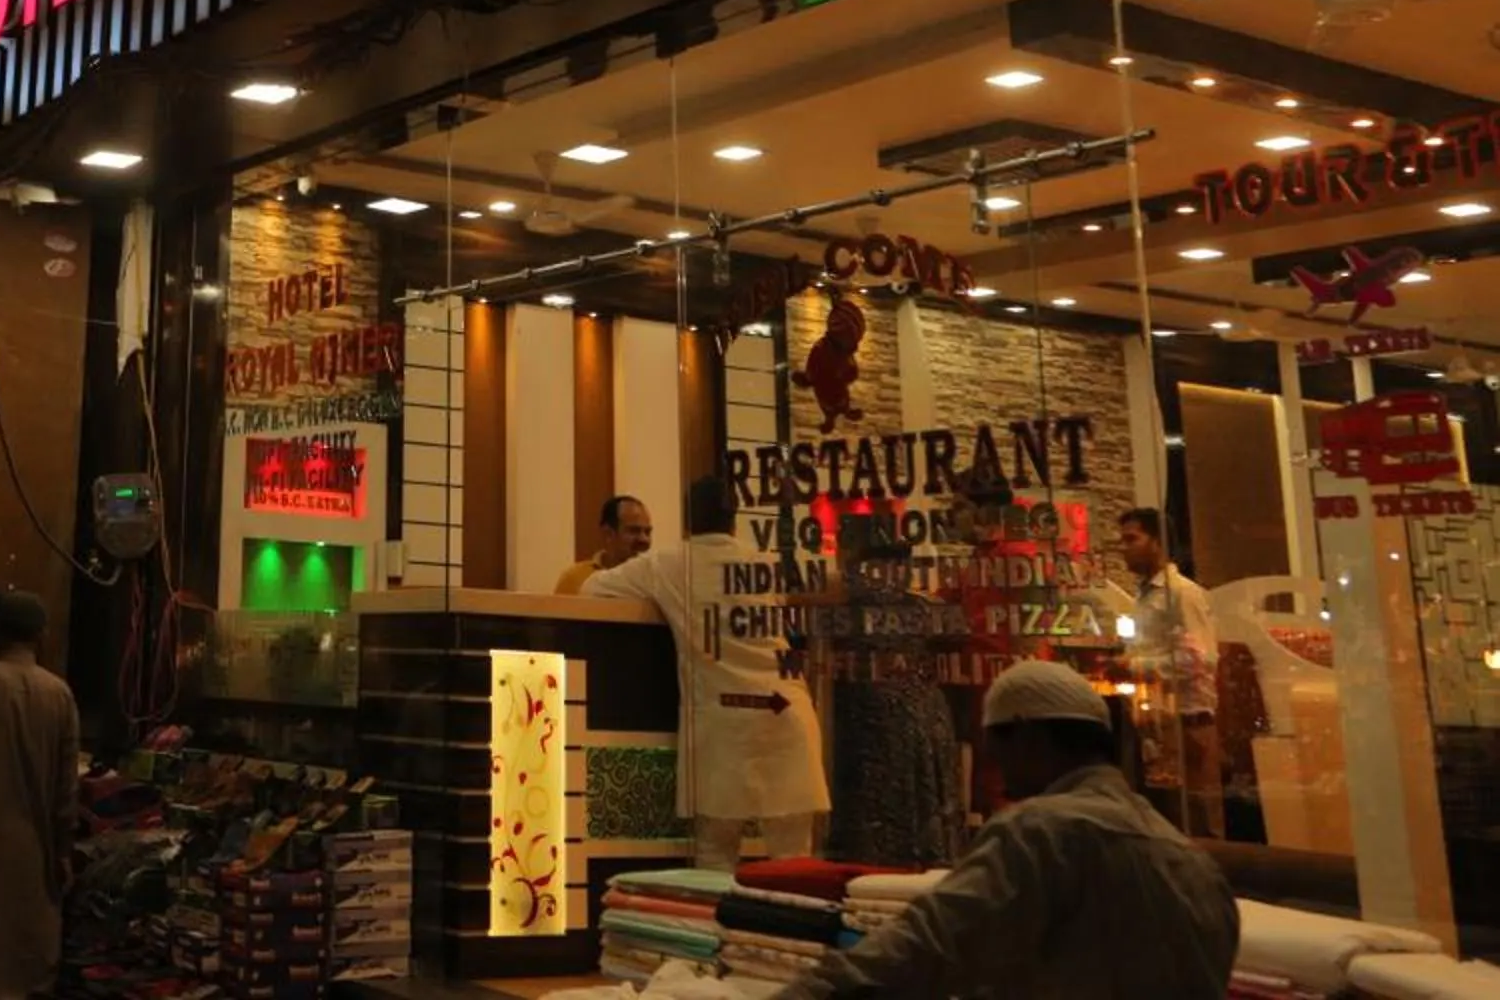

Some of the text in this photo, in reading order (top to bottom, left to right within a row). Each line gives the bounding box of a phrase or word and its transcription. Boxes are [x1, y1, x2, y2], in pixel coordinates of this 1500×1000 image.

[1193, 144, 1369, 225] TOUR
[267, 262, 349, 323] HOTEL
[226, 340, 298, 398] ROYAL
[725, 417, 1094, 507] RESTAURANT
[871, 510, 957, 549] NON
[724, 559, 828, 596] INDIAN
[985, 602, 1103, 636] PIZZA
